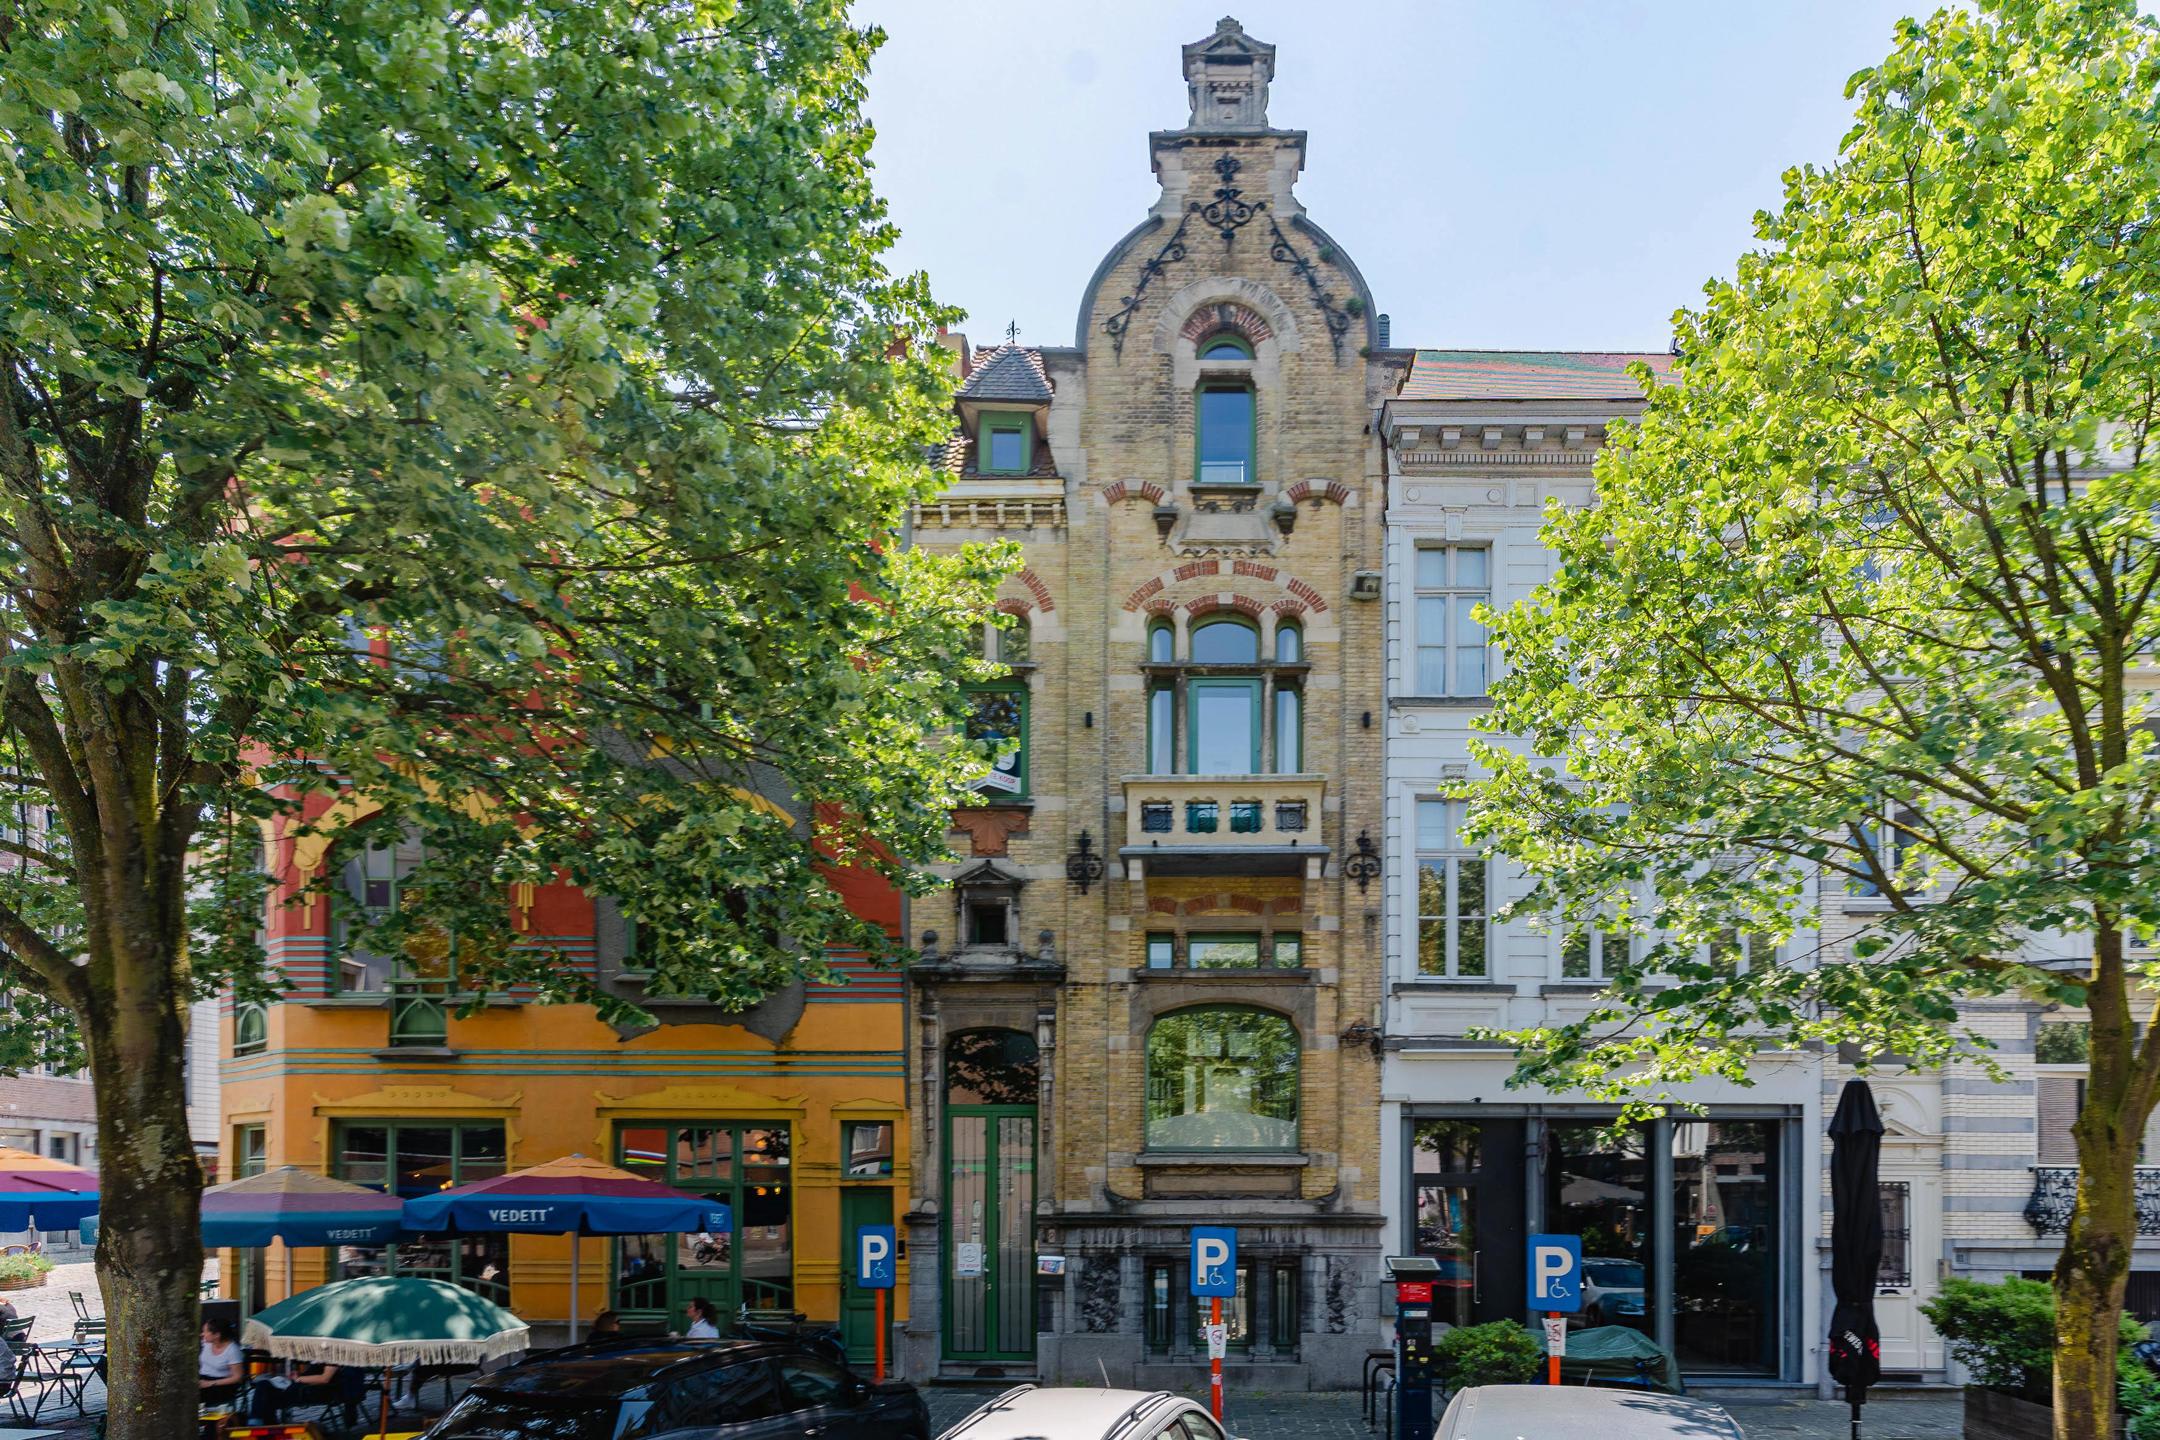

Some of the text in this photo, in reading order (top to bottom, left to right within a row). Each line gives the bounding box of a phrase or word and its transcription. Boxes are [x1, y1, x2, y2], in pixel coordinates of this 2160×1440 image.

[326, 1228, 372, 1239] VEDETT
[489, 1209, 548, 1222] VEDETT
[863, 1235, 888, 1278] P
[1197, 1238, 1229, 1285] P
[1536, 1246, 1573, 1298] P
